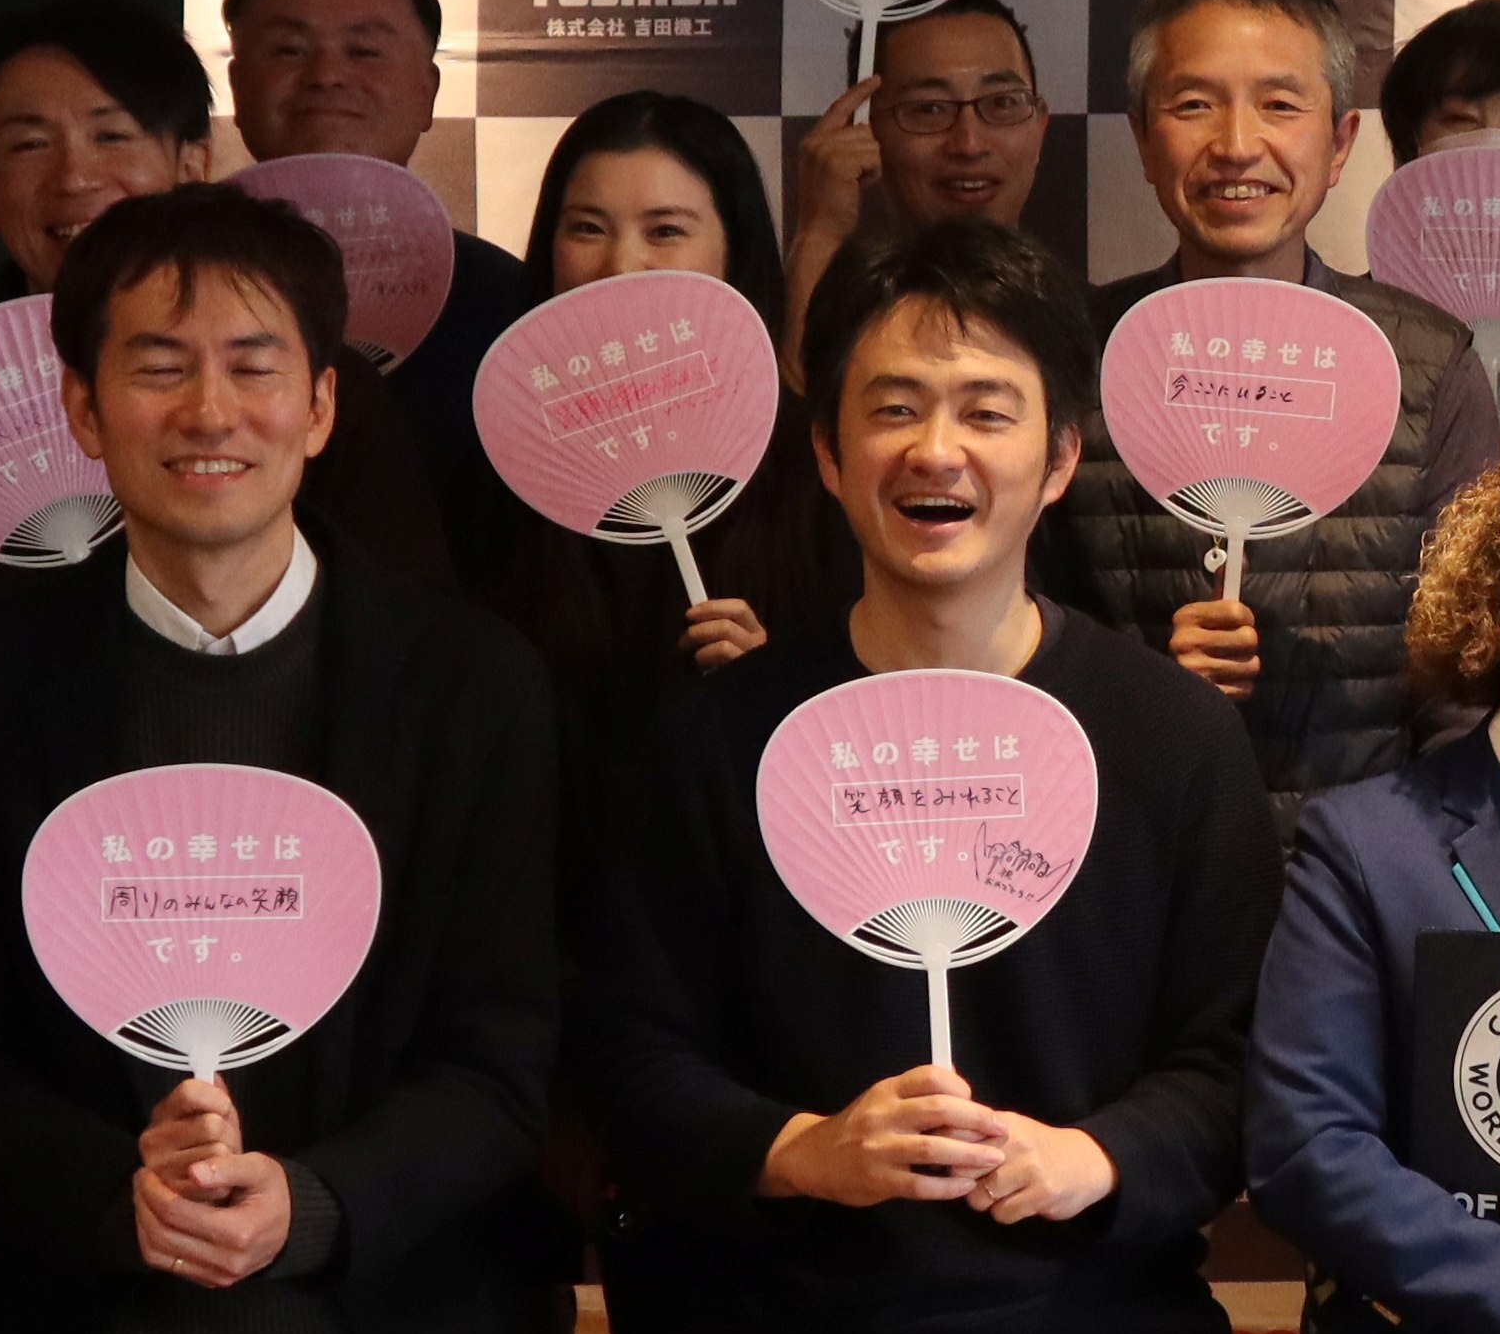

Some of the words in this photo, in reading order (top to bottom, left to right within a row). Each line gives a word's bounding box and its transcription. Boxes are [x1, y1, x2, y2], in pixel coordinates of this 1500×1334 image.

[546, 17, 626, 39] 株式会社
[632, 17, 713, 38] 吉田機工
[528, 318, 696, 392] 私の幸せは
[1170, 331, 1337, 369] 私の幸せは
[596, 423, 678, 460] です。
[1199, 422, 1279, 452] です。
[0, 449, 79, 485] です。
[830, 734, 1021, 769] 私の幸せは
[843, 786, 1021, 815] 笑顔をみれること
[101, 833, 301, 864] 私の幸せは
[876, 835, 970, 865] です。
[109, 885, 299, 918] 周りのみんなの笑顔
[146, 934, 243, 965] です。
